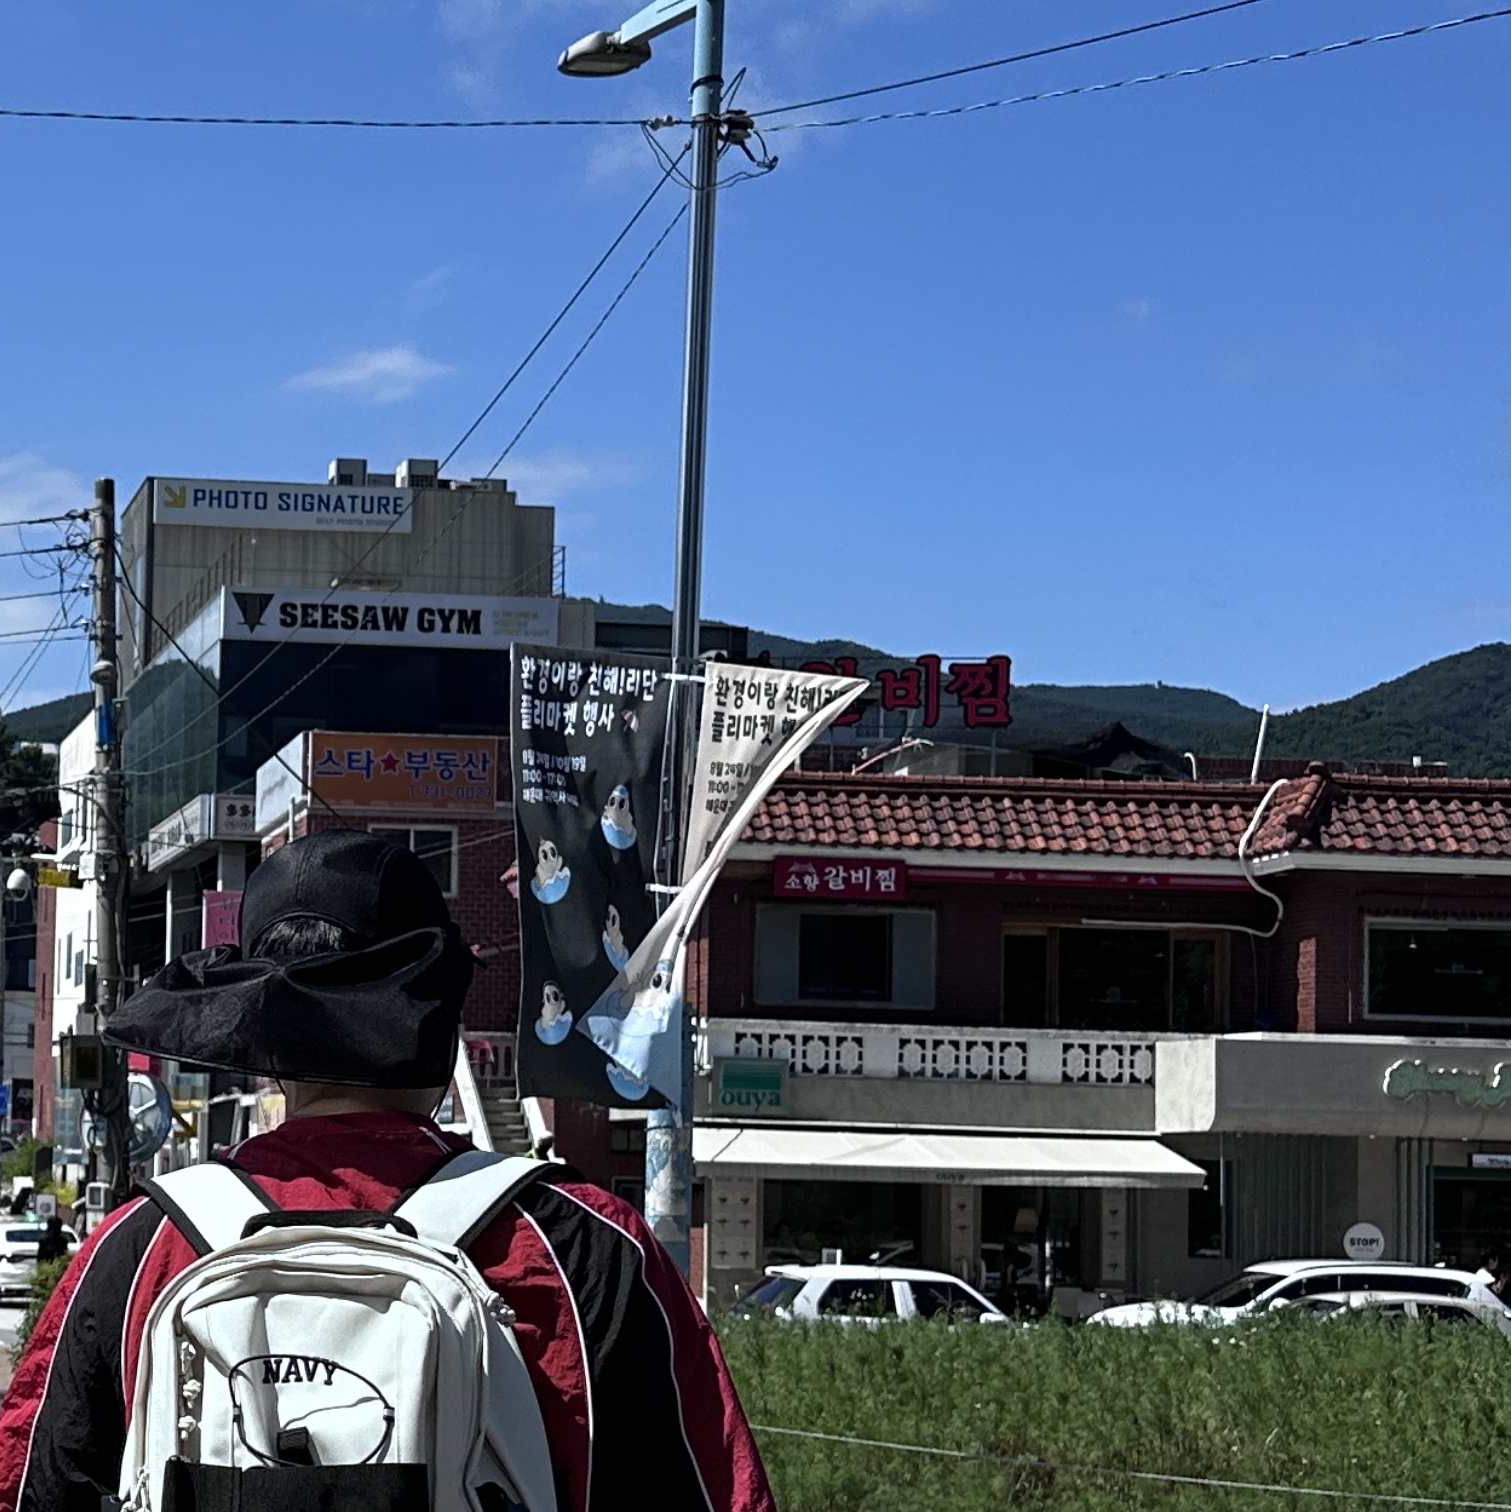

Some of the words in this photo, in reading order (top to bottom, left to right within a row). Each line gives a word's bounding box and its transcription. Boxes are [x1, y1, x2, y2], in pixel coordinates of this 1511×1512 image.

[193, 489, 268, 510] PHOTO
[278, 492, 405, 515] SIGNATURE
[279, 602, 409, 633] SEESAW
[417, 607, 482, 635] GYM
[521, 655, 583, 697] 환경이랑
[715, 676, 778, 710] 환경이랑
[521, 694, 578, 736] 플리마켓
[583, 700, 615, 737] 행사
[712, 711, 775, 746] 플리마켓
[315, 748, 375, 780] 스타
[403, 751, 493, 782] 부동산
[823, 865, 897, 892] 갈비찜
[720, 1089, 782, 1112] ouya
[263, 1356, 338, 1386] NAVY
